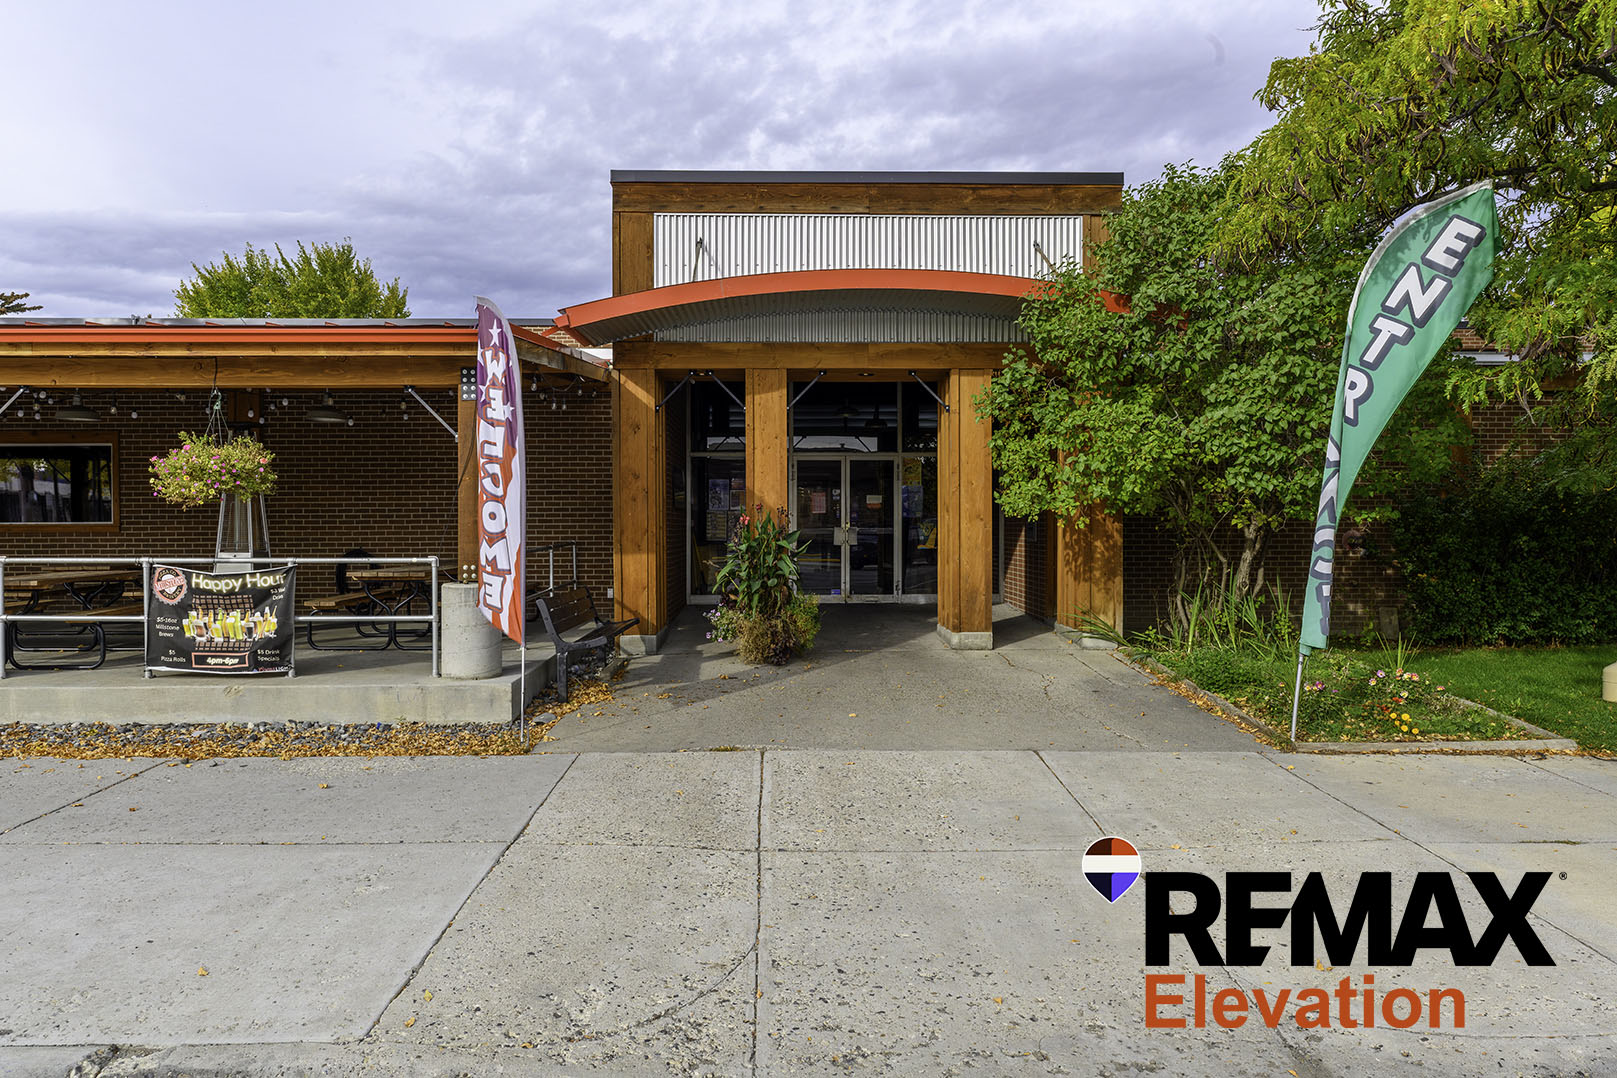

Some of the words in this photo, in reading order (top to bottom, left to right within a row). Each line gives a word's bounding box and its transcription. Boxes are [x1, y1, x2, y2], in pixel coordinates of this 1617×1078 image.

[479, 346, 512, 614] WELCOME
[191, 573, 242, 593] Happy
[246, 572, 287, 588] Hour
